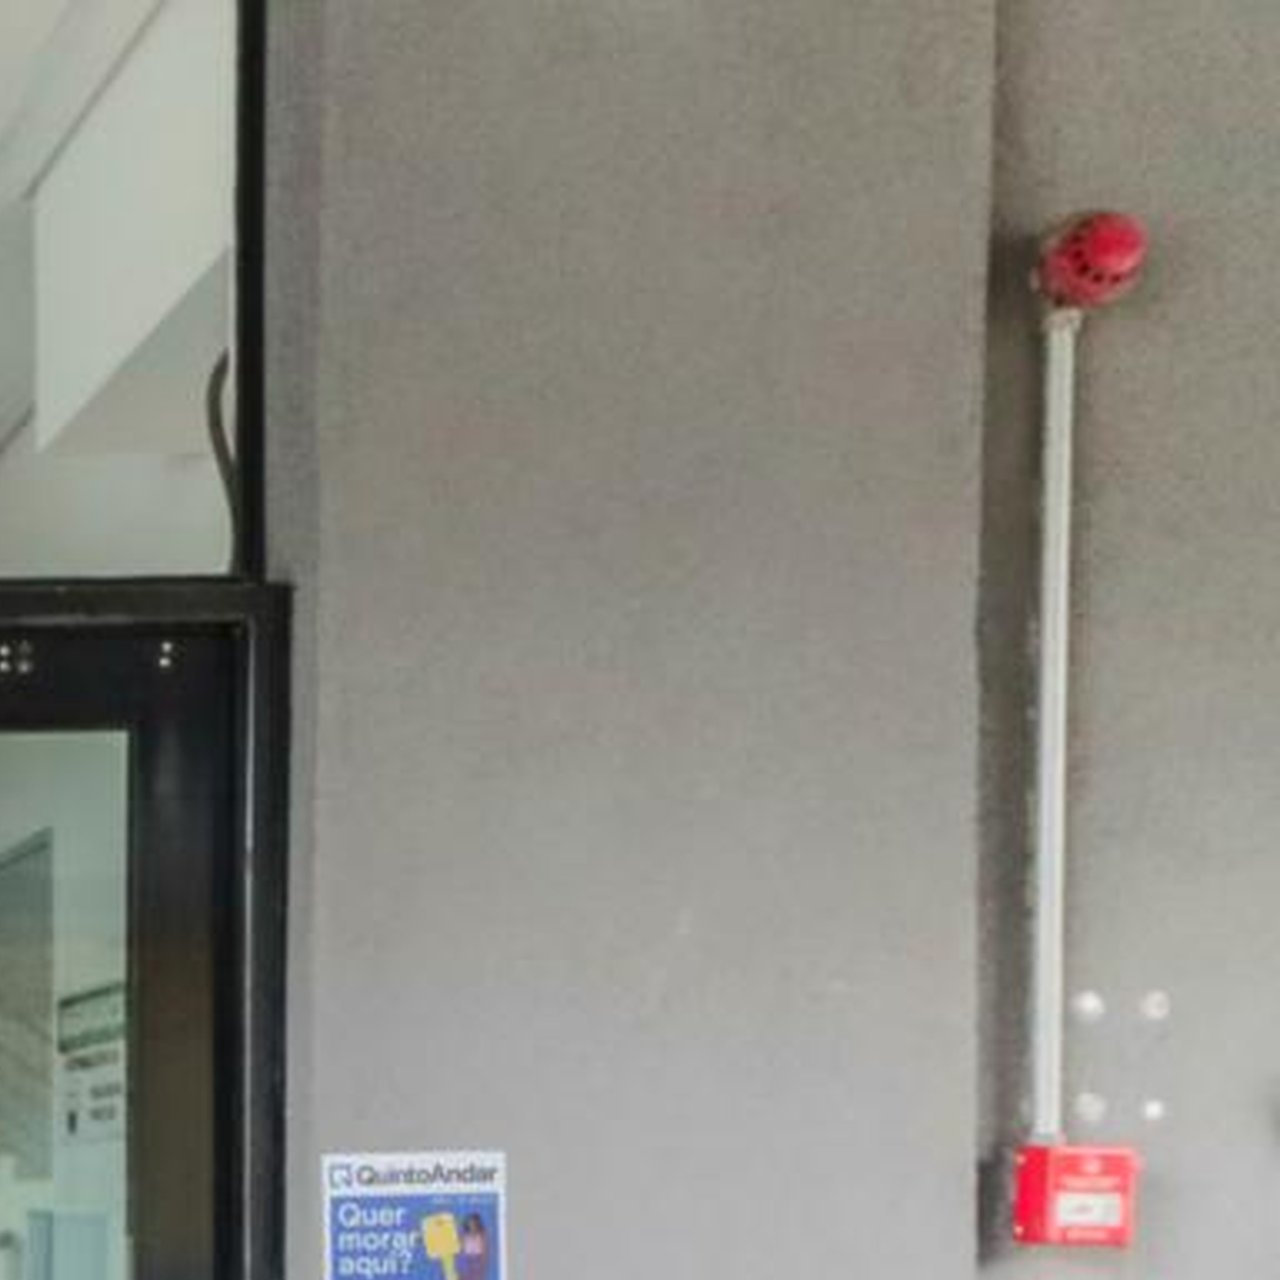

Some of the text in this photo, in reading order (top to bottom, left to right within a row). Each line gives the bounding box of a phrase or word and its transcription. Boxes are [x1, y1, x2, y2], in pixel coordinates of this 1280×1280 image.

[357, 1161, 497, 1184] QuintoAndar
[338, 1202, 407, 1228] Quer
[338, 1230, 422, 1251] morar
[338, 1249, 414, 1279] aqui?
